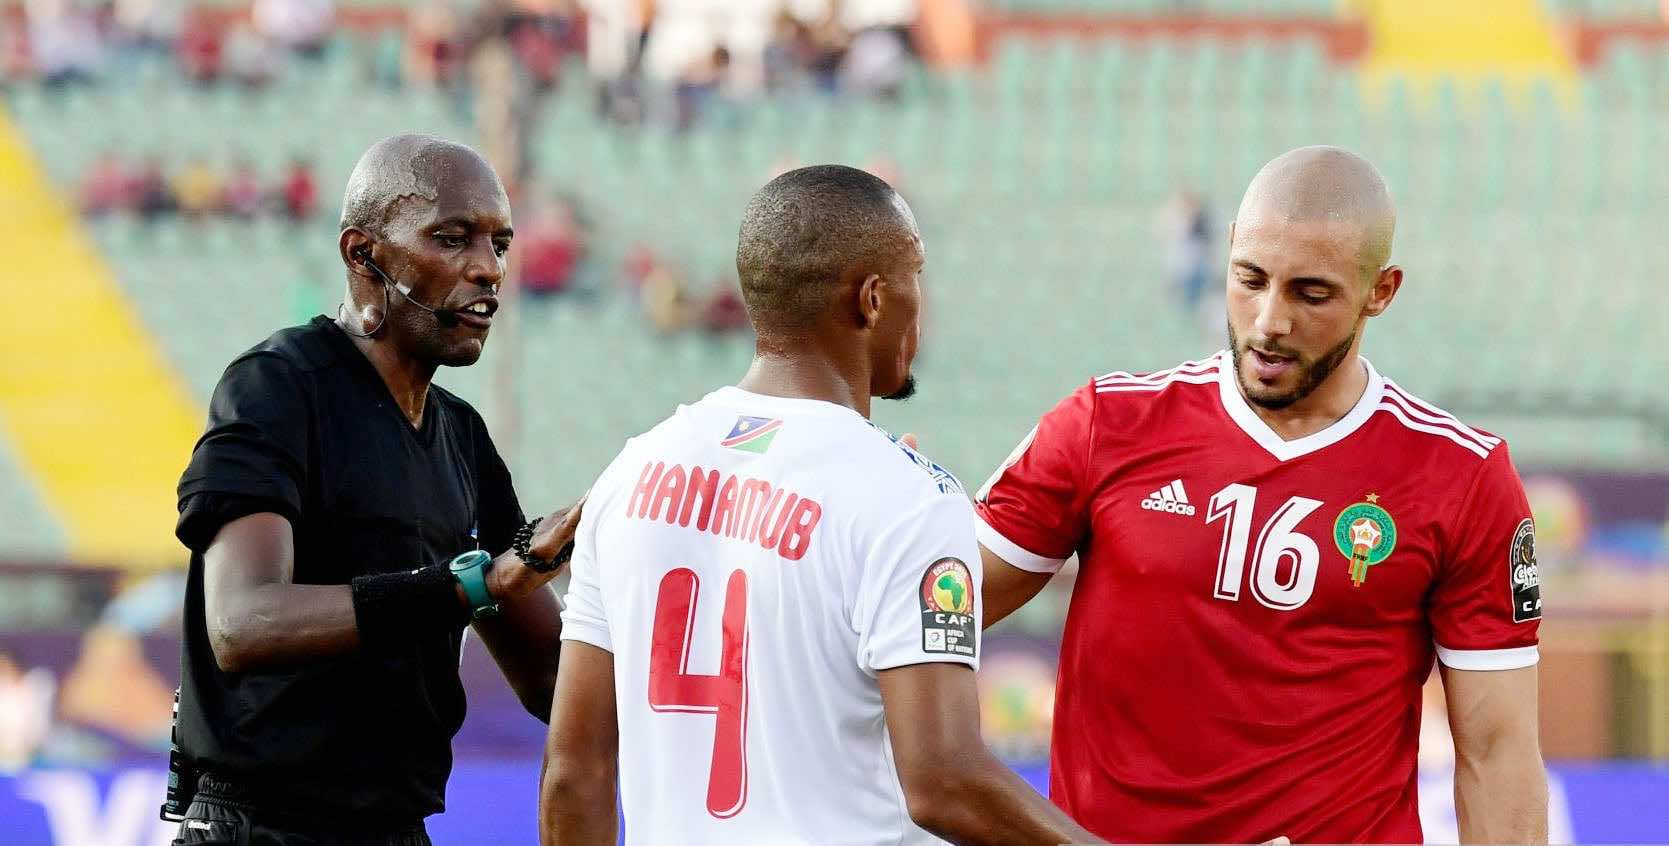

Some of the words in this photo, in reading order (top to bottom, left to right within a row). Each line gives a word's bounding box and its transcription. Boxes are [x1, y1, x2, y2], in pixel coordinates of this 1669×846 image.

[626, 461, 822, 561] HANAMUB
[1141, 498, 1196, 516] adidas
[1205, 483, 1325, 611] 16
[935, 613, 967, 626] CAF
[1522, 599, 1542, 612] CA
[648, 567, 750, 819] 4
